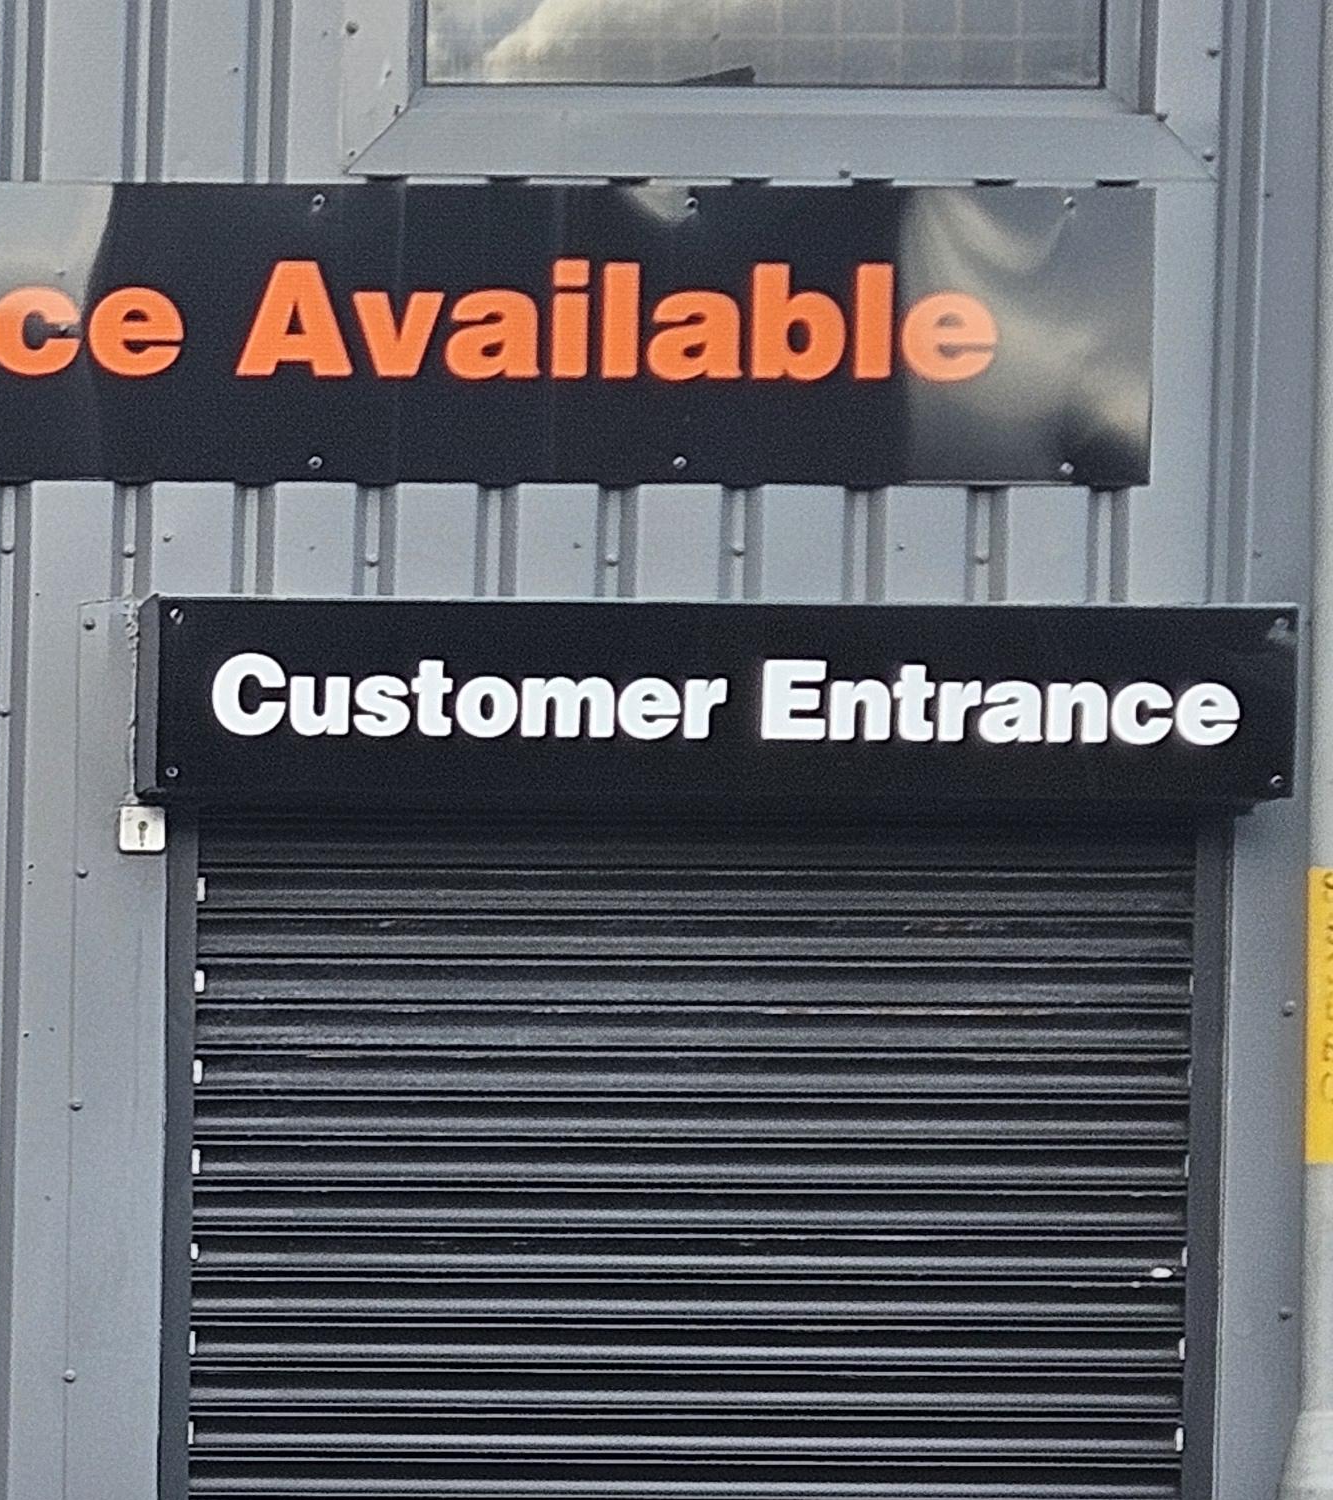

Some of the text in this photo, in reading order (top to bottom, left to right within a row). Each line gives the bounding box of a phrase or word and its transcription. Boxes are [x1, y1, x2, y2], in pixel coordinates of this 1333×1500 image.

[237, 261, 994, 380] Available
[212, 653, 1239, 745] Customer Entrance
